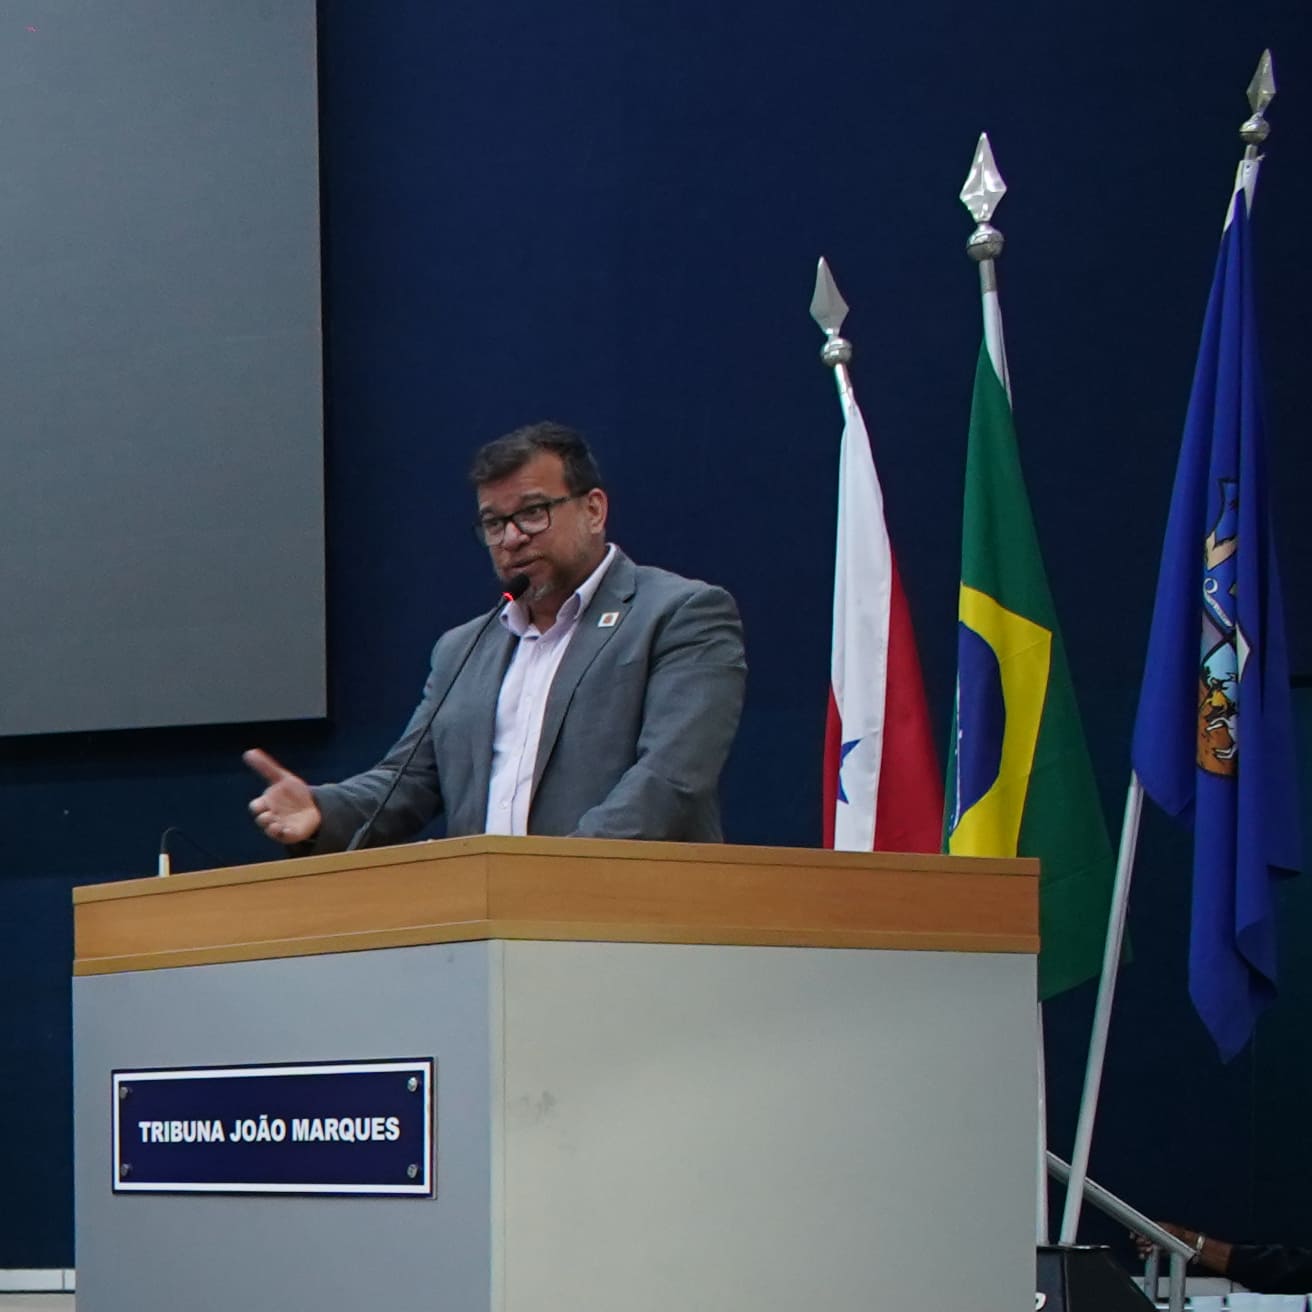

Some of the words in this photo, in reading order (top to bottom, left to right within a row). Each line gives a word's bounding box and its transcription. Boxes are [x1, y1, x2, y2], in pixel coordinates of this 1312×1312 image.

[139, 1120, 225, 1143] TRIBUNA
[229, 1114, 286, 1143] JOÃO
[292, 1117, 400, 1143] MARQUES
